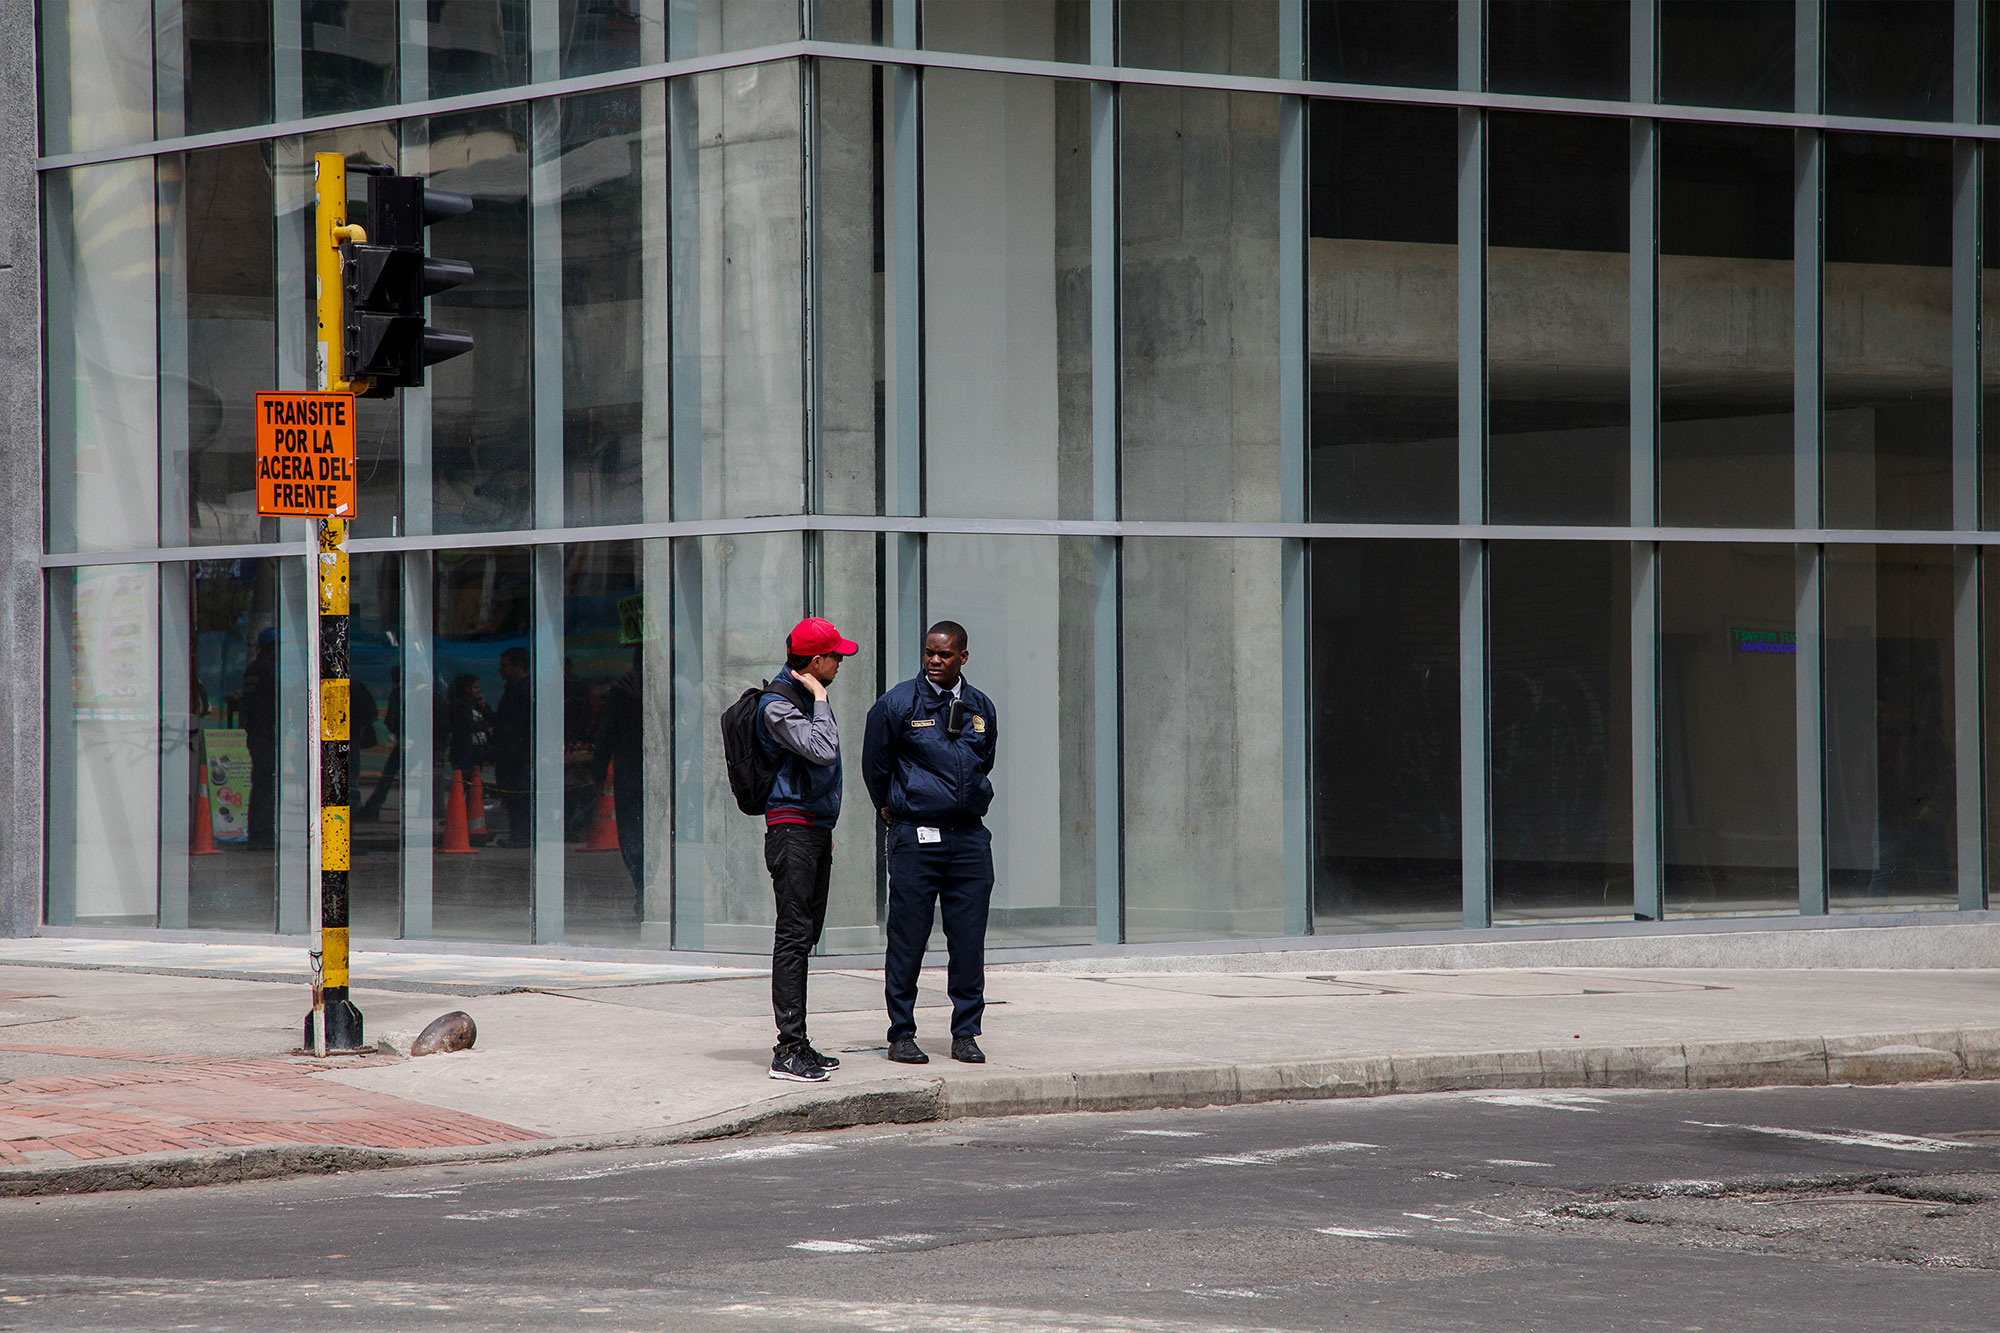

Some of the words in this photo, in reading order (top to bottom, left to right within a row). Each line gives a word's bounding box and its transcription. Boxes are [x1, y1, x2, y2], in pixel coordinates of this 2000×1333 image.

[264, 401, 346, 425] TRANSITE
[275, 429, 308, 453] POR
[313, 430, 334, 453] LA
[260, 456, 314, 480] ACERA
[319, 457, 351, 481] DEL
[273, 484, 337, 508] FRENTE
